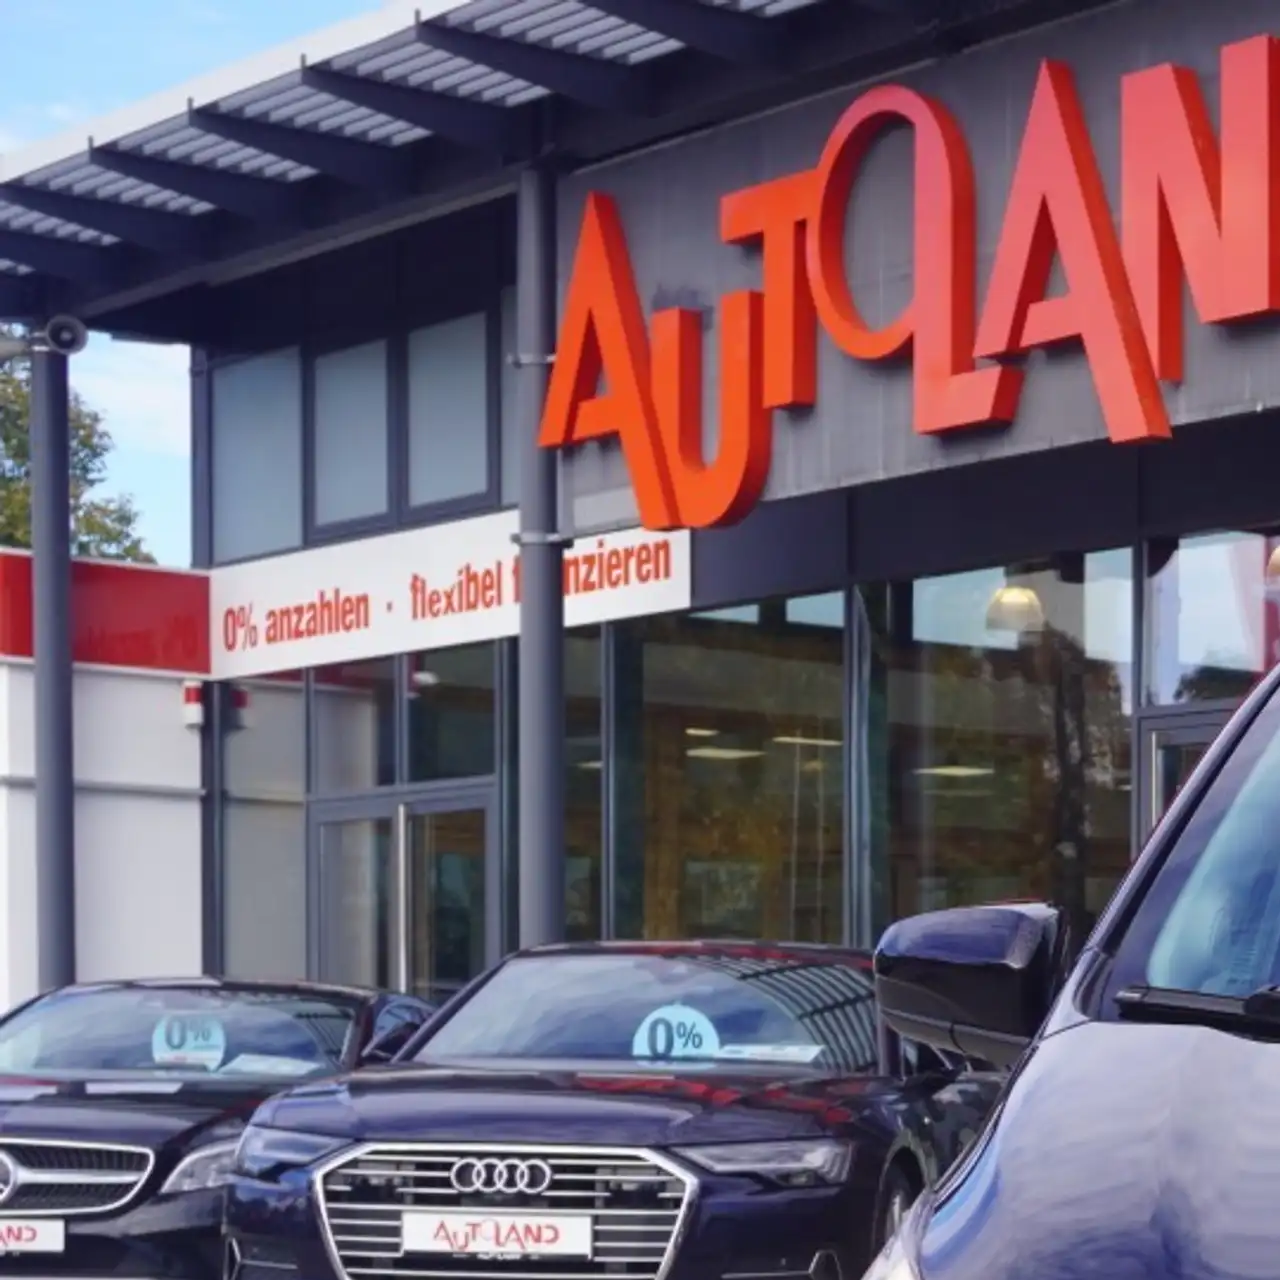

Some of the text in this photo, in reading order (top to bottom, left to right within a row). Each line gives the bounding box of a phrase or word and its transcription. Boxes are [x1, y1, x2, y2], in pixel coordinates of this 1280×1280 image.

[223, 602, 258, 651] 0%
[265, 588, 369, 644] anzahlen
[410, 573, 502, 620] flexibel
[512, 539, 671, 603] fnzieren
[647, 1017, 703, 1059] 0%
